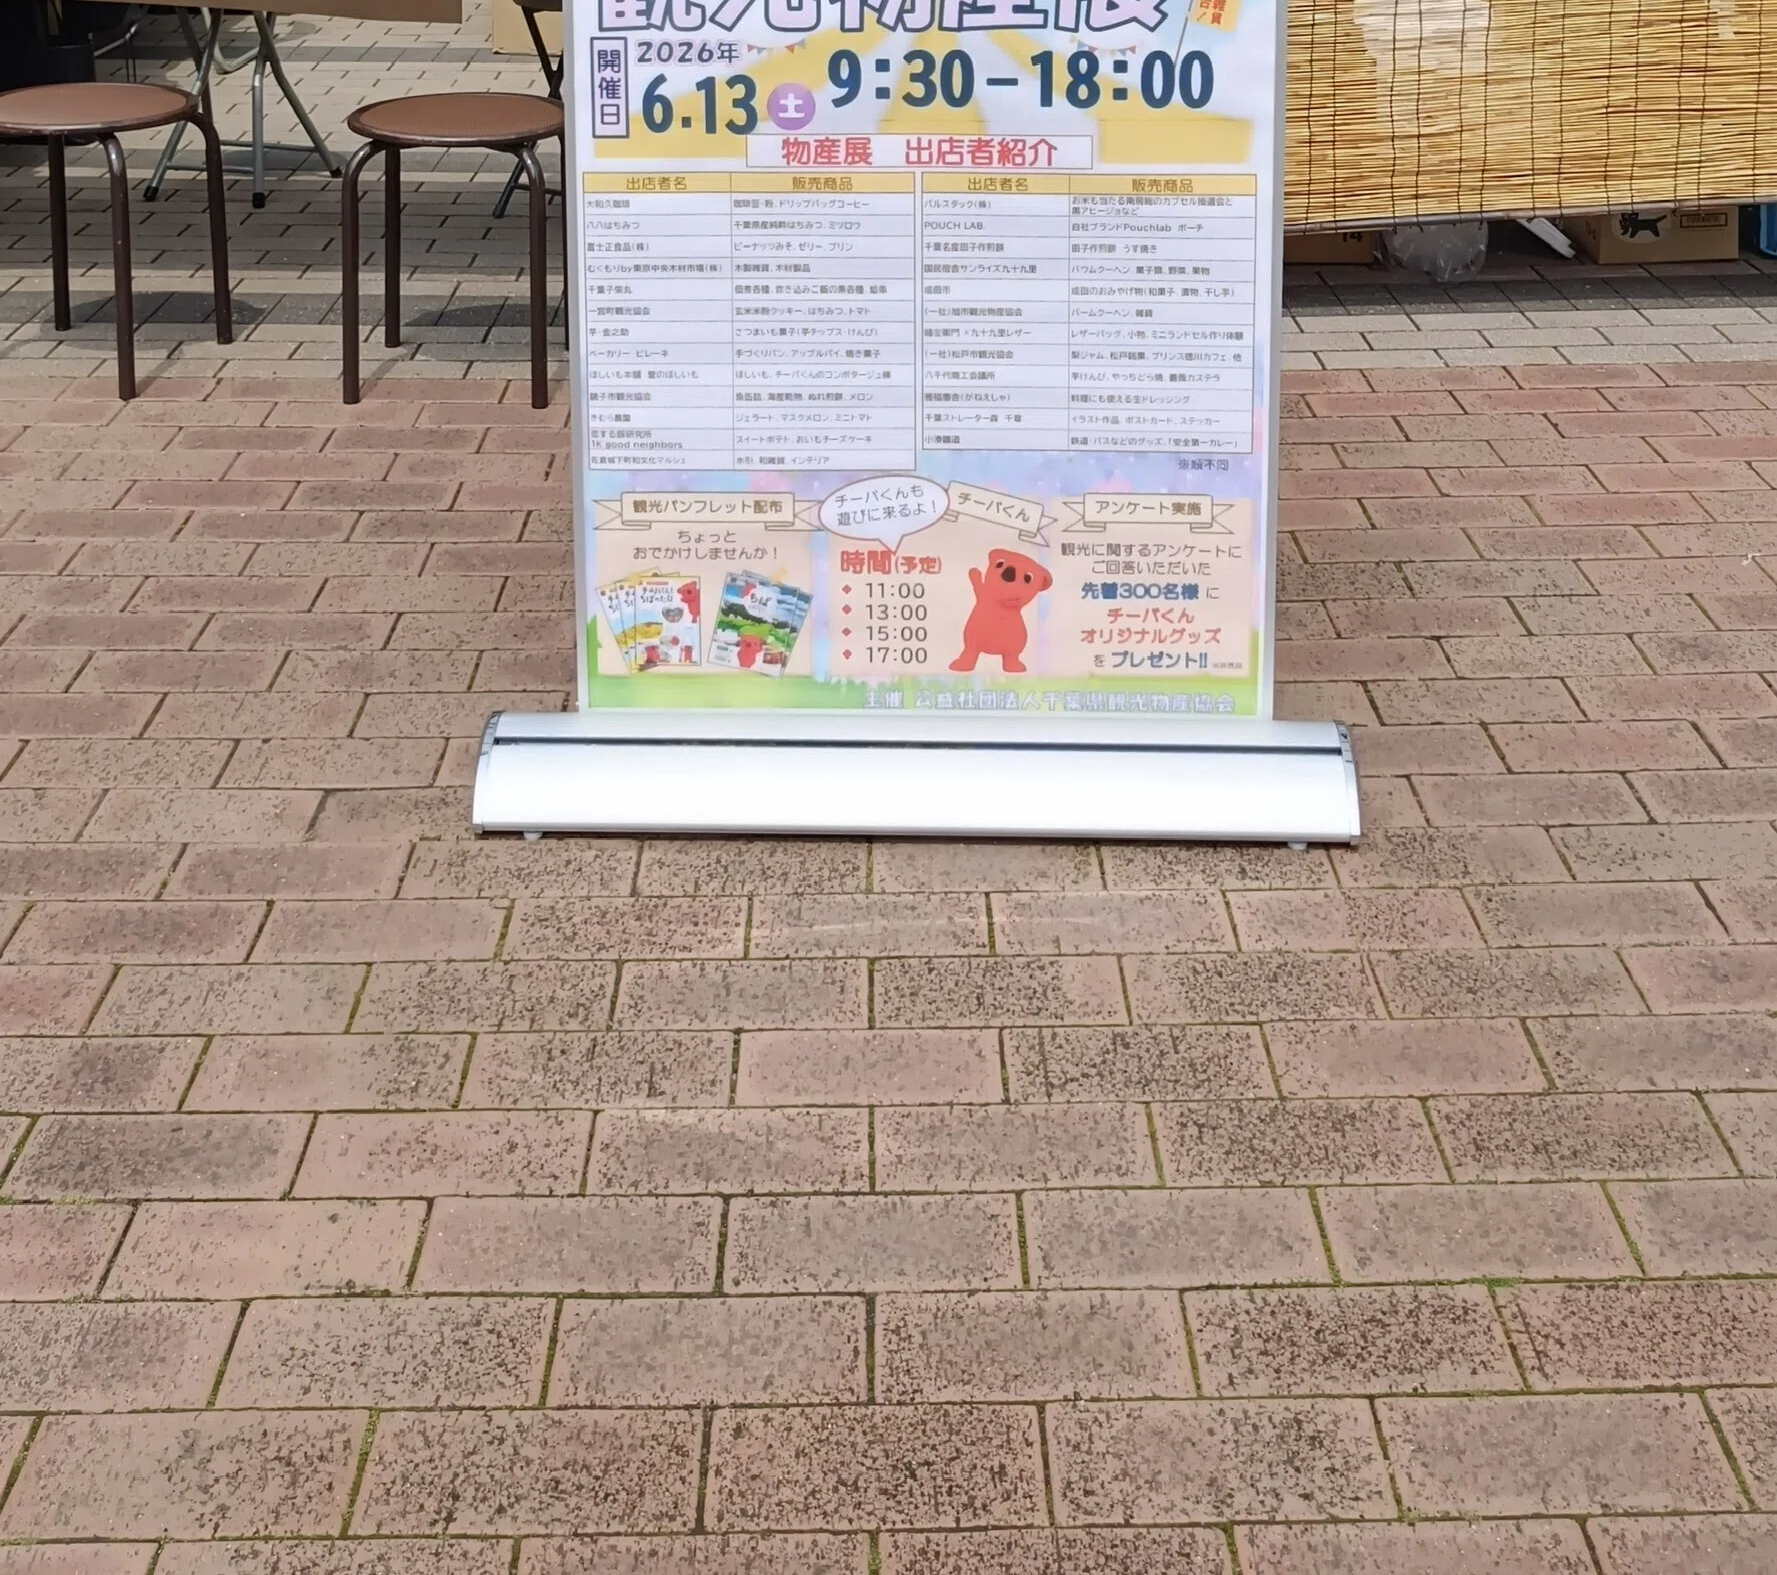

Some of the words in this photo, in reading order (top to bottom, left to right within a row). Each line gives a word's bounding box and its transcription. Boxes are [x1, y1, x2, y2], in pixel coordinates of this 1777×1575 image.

[636, 40, 741, 65] 2026年
[598, 50, 622, 125] 開催日
[642, 74, 758, 135] 6.13
[776, 94, 803, 121] 土
[781, 136, 873, 166] 物産展
[905, 137, 1058, 167] 出店者紹介
[626, 176, 688, 191] 出店者名
[792, 176, 853, 191] 販売商品
[967, 177, 1029, 192] 出店者名
[1132, 178, 1194, 193] 販売商品
[924, 221, 961, 230] POUCH
[964, 221, 984, 230] LAB
[1177, 223, 1204, 233] ポーチ
[605, 441, 630, 450] good
[835, 484, 925, 507] チーバくんも
[632, 499, 783, 515] 観光パンフレット配布
[836, 499, 938, 527] 遊びに来るよ!
[957, 491, 1031, 524] チーバくん
[1095, 500, 1203, 517] アンケート実施
[677, 530, 737, 543] ちょっと
[632, 546, 779, 561] おでかけしませんか!
[1061, 543, 1242, 559] 観光に関するアンケートに
[1091, 561, 1212, 576] ご回答いただいた
[866, 581, 925, 599] 11:00
[866, 603, 928, 621] 13:00
[1107, 607, 1195, 625] チーバくん
[866, 626, 928, 642] 15:00
[1081, 628, 1221, 645] オリジナルグッズ
[866, 646, 928, 664] 17:00
[864, 690, 904, 709] 主催
[914, 690, 1236, 712] 公益社団法人千葉県観光物産協会
